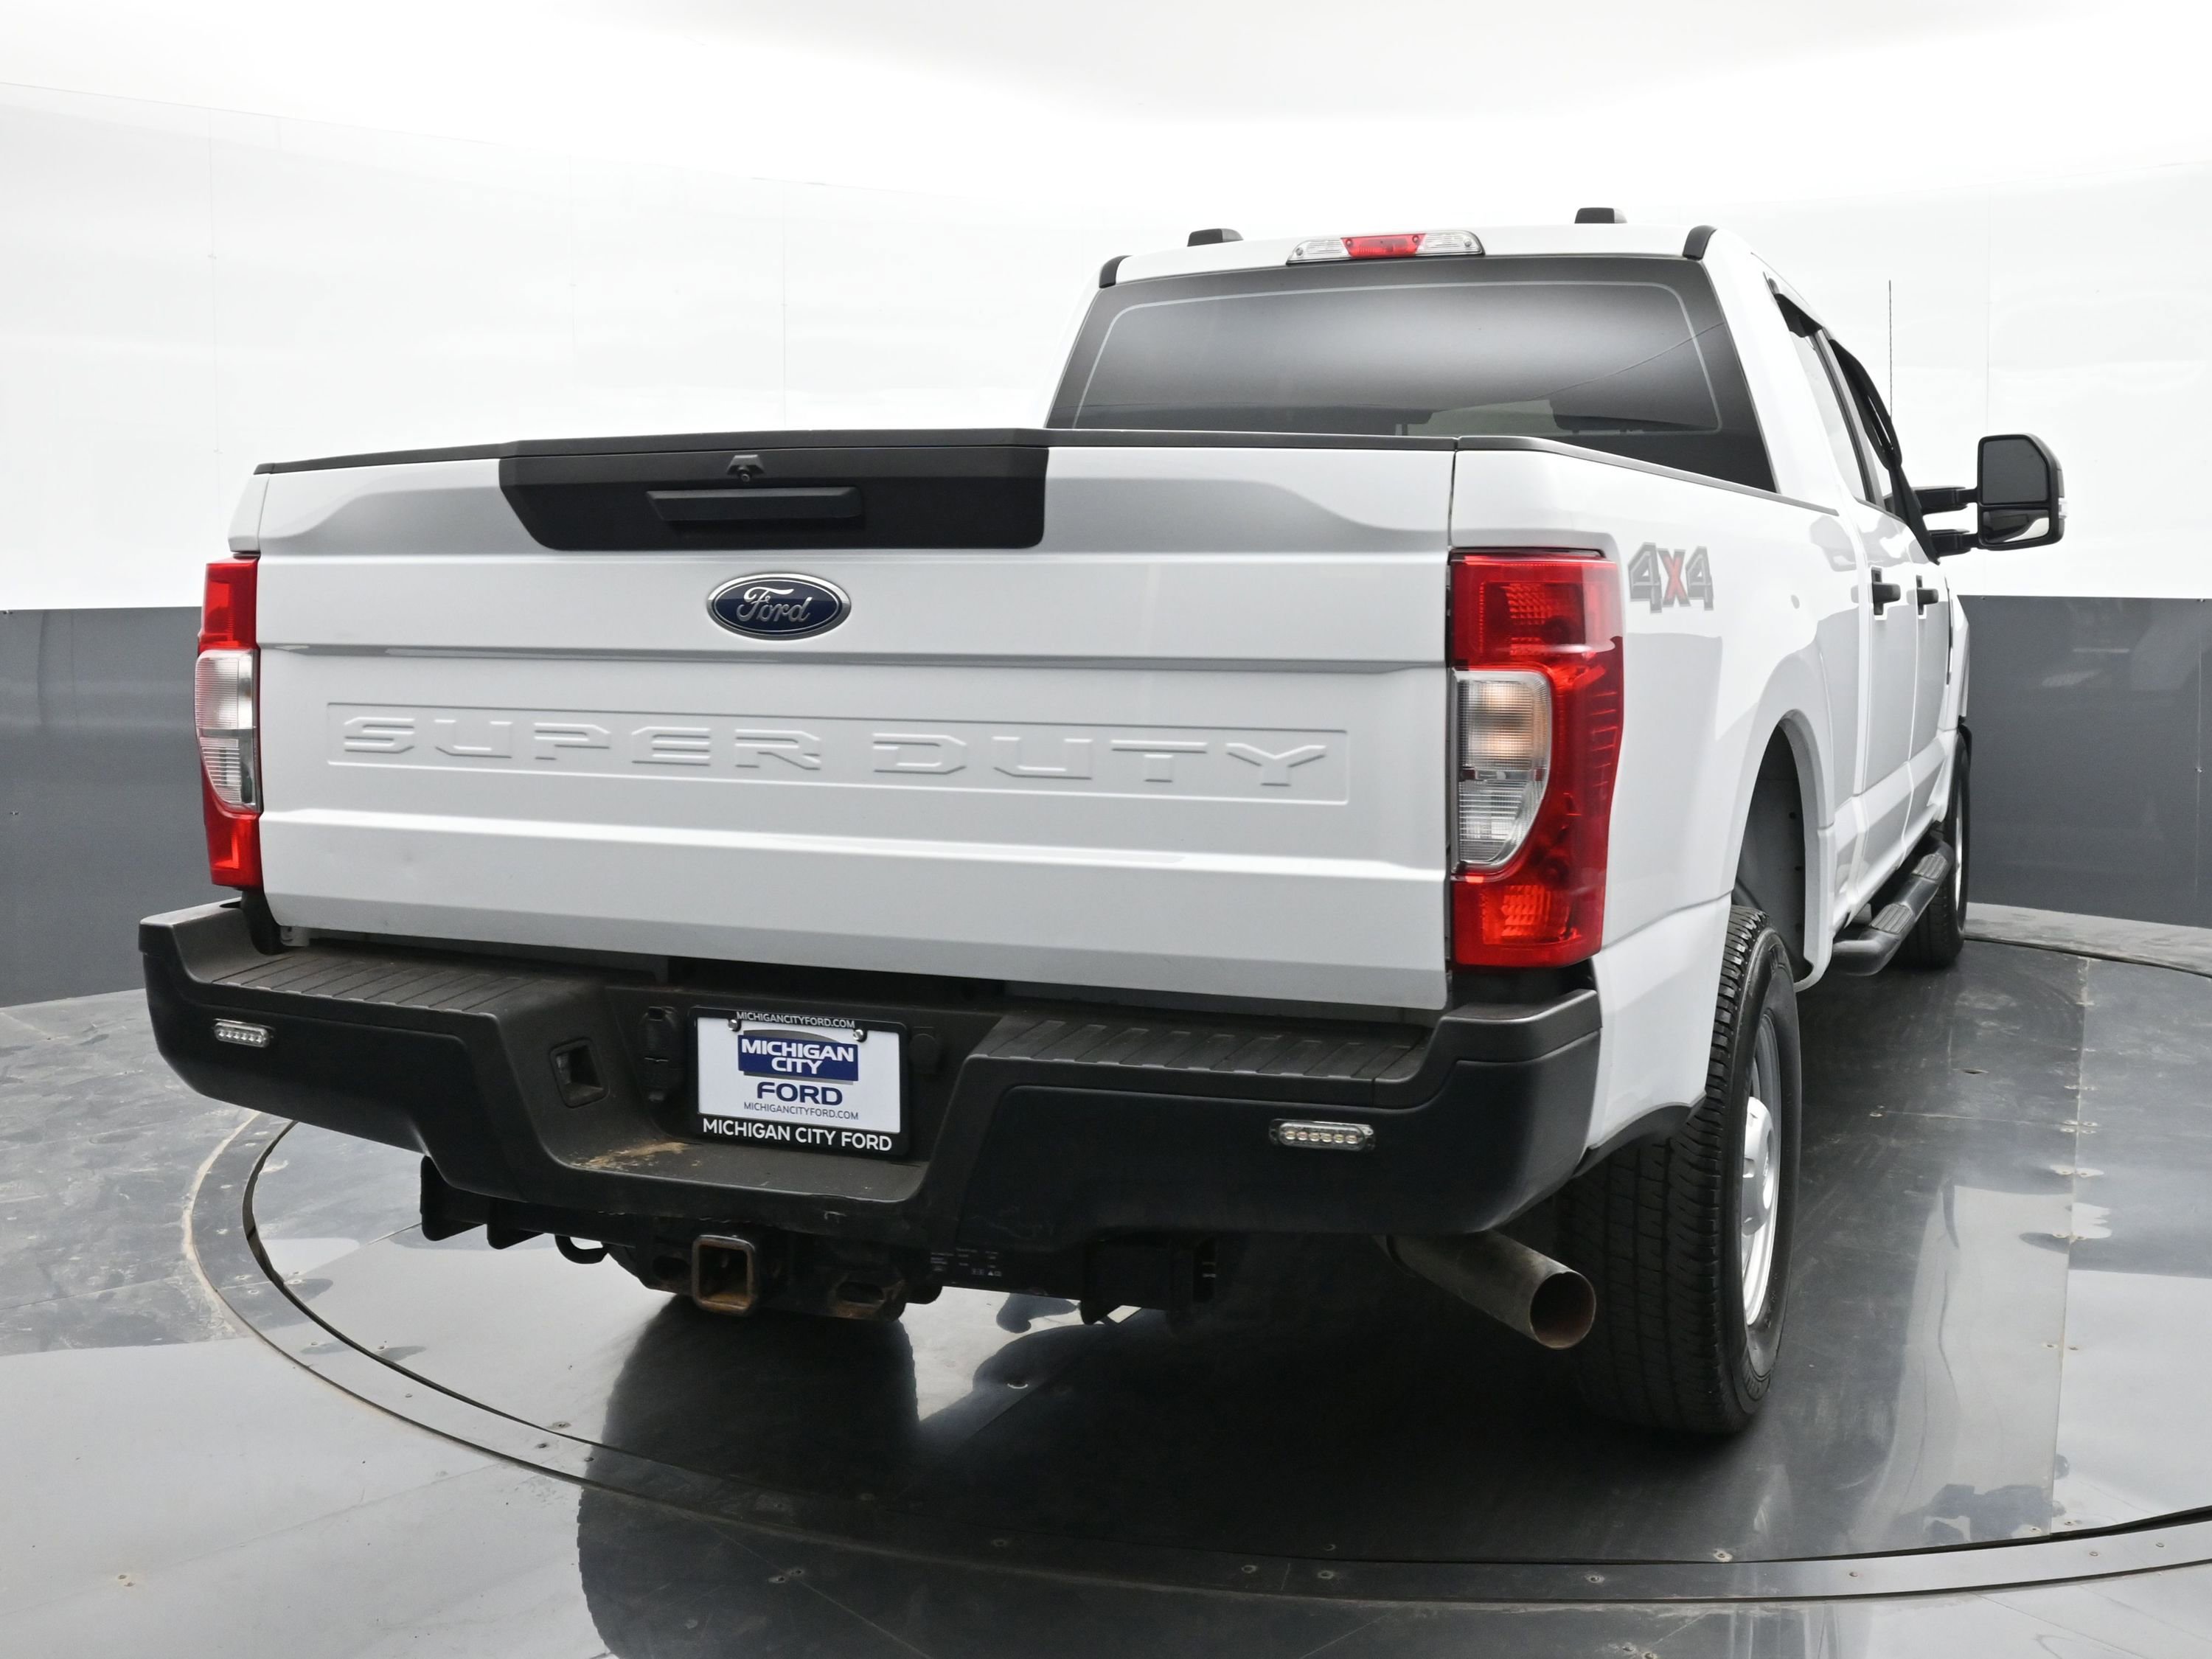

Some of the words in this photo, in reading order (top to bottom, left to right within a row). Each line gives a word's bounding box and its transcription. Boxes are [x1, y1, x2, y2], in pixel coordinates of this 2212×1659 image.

[737, 586, 813, 622] Ford
[344, 716, 821, 771] SUPER
[873, 732, 1326, 787] DUTY
[737, 1011, 855, 1029] MICHIGANCITYFORD.COM
[741, 1038, 854, 1062] MICHIGAN
[771, 1057, 824, 1074] CITY
[757, 1081, 843, 1106] FORD
[743, 1102, 859, 1120] MICHIGANCITYFORD.COM
[703, 1118, 790, 1141] MICHIGAN
[795, 1127, 835, 1145] CITY
[841, 1131, 892, 1152] FORD
